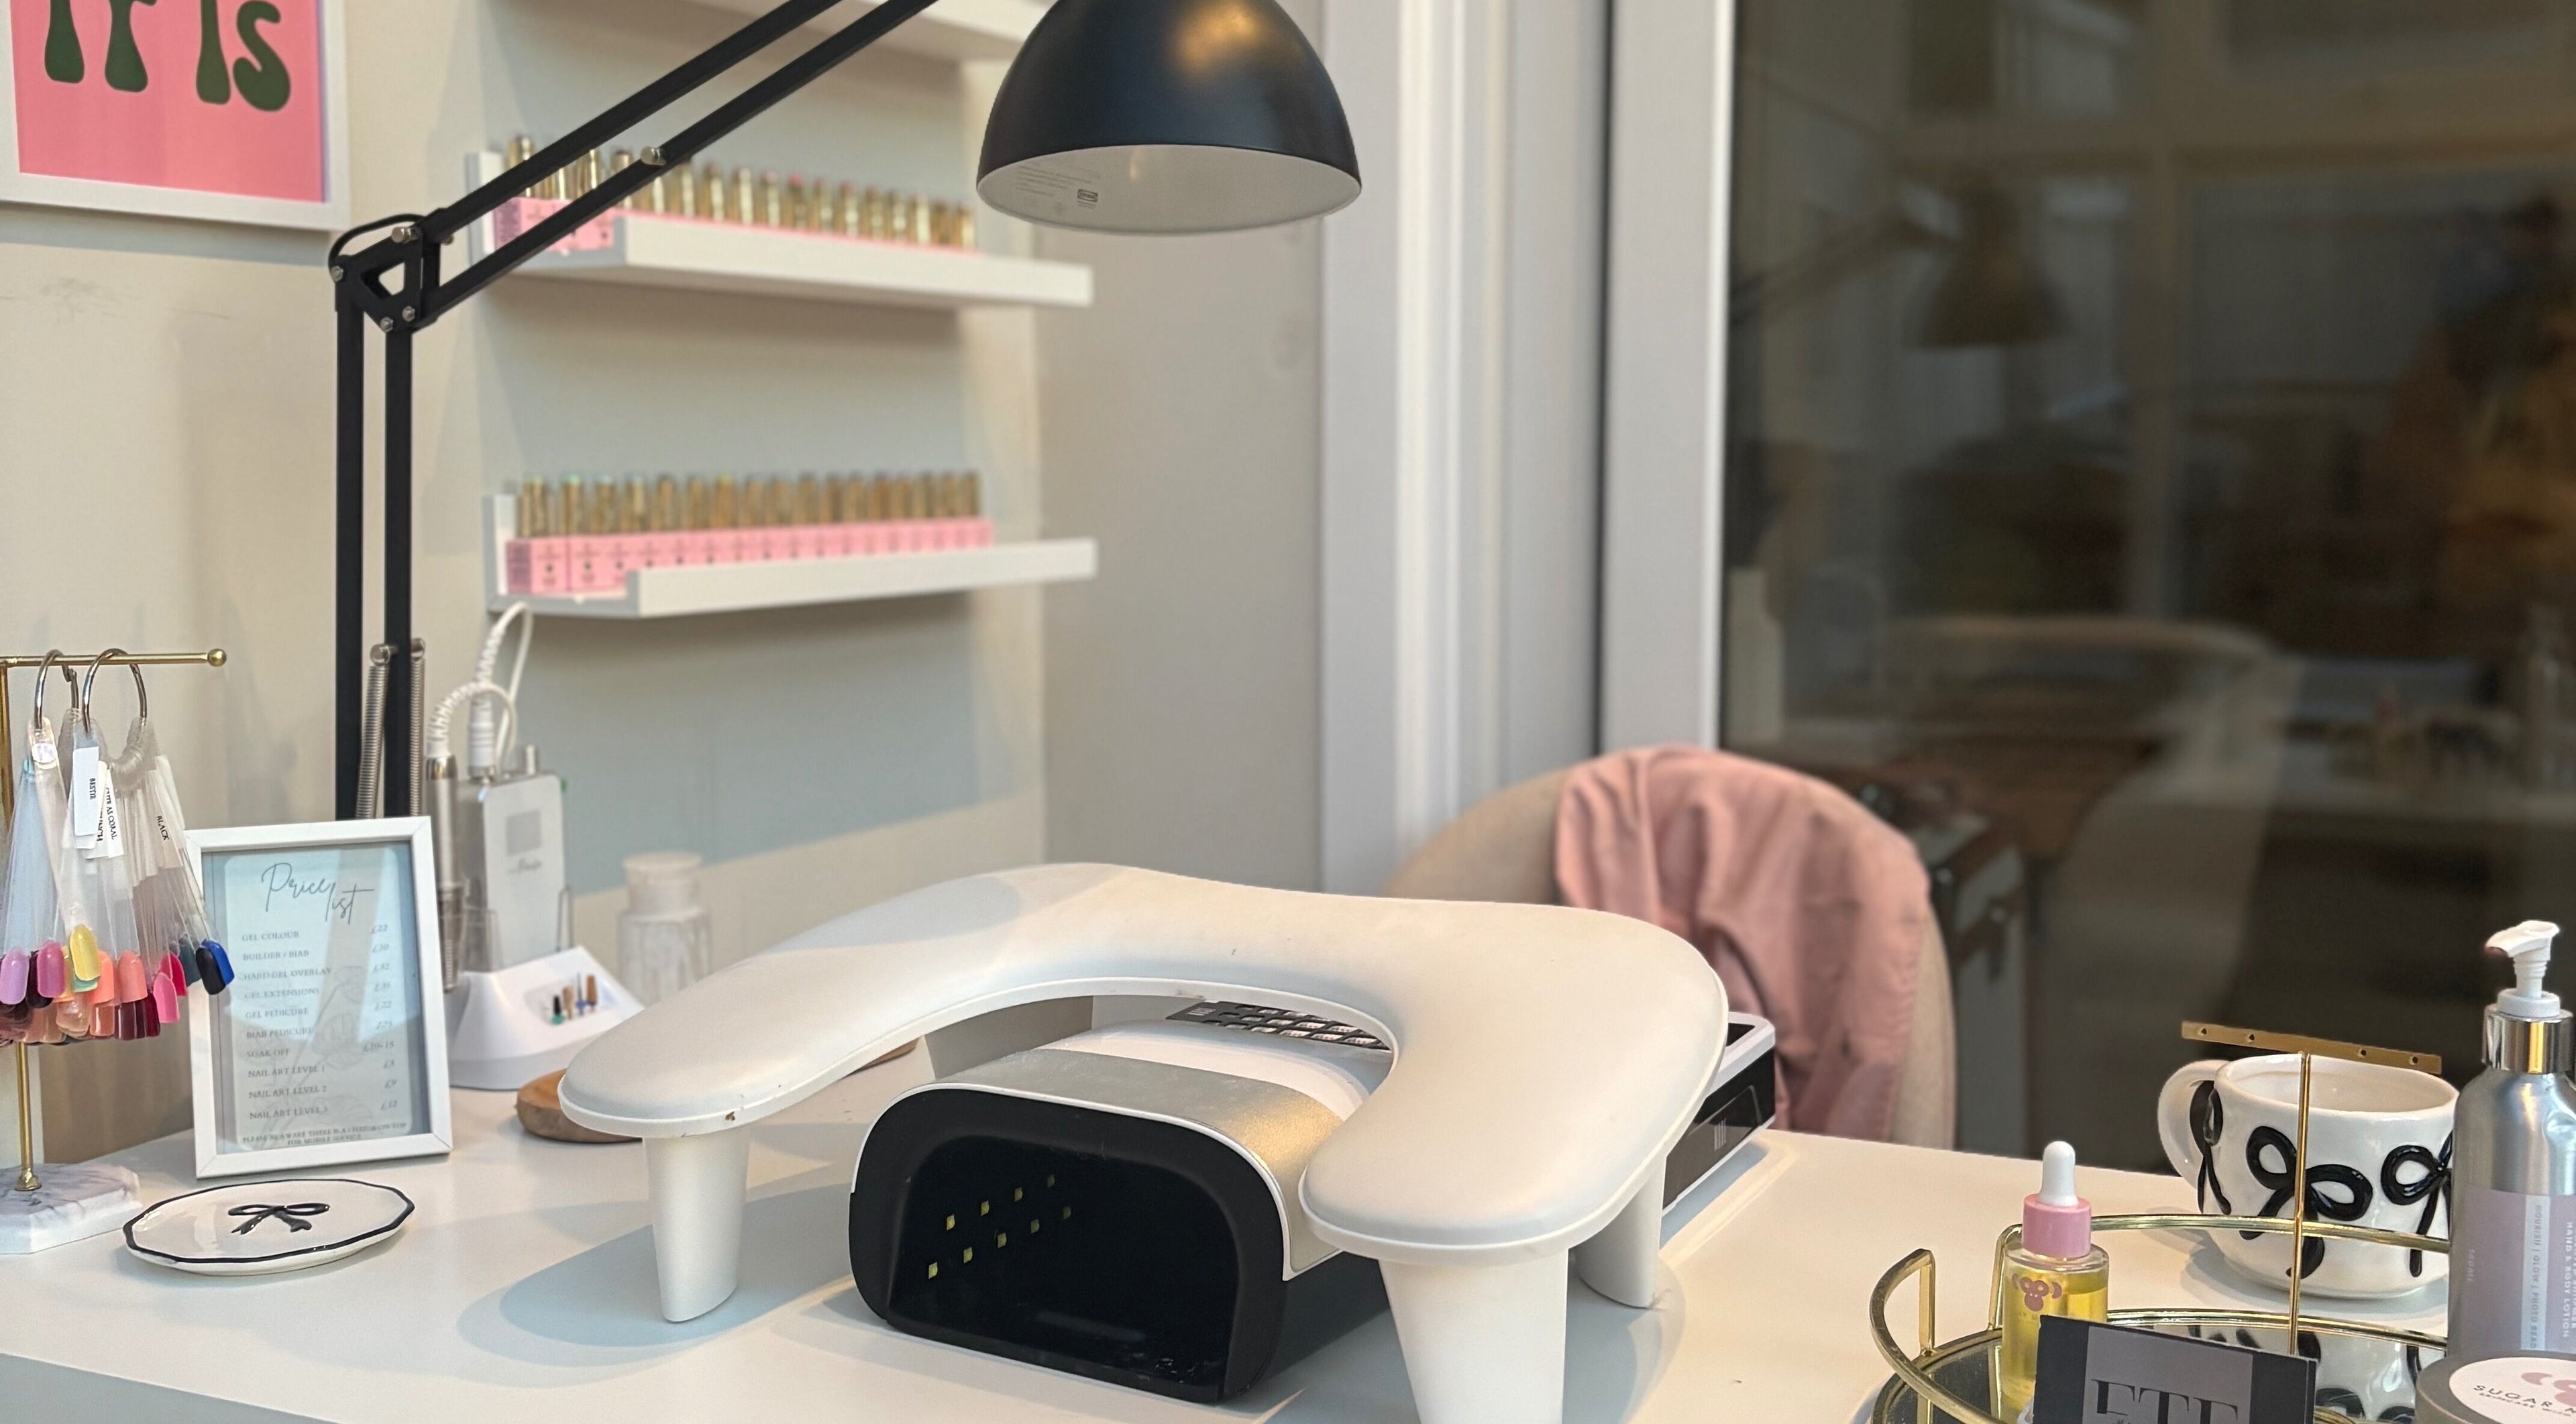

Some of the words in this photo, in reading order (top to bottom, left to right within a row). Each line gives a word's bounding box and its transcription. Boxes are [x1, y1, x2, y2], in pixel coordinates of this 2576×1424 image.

[156, 815, 170, 841] BLACK
[262, 862, 331, 912] Price
[242, 932, 259, 942] GEL
[261, 930, 300, 941] COLOUR
[243, 952, 281, 961] BUILDER
[288, 950, 309, 959] BIAB
[272, 971, 288, 979] GEL
[290, 967, 332, 977] OVERLAY
[264, 987, 320, 998] EXTENSIONS
[248, 1070, 270, 1078] NAIL
[272, 1067, 289, 1076] ART
[249, 1090, 270, 1099] NAIL
[272, 1088, 290, 1096] ART
[250, 1111, 270, 1119] NAIL
[2565, 1221, 2573, 1252] HAND
[2564, 1265, 2572, 1295] BODY
[2563, 1298, 2571, 1338] LOTION
